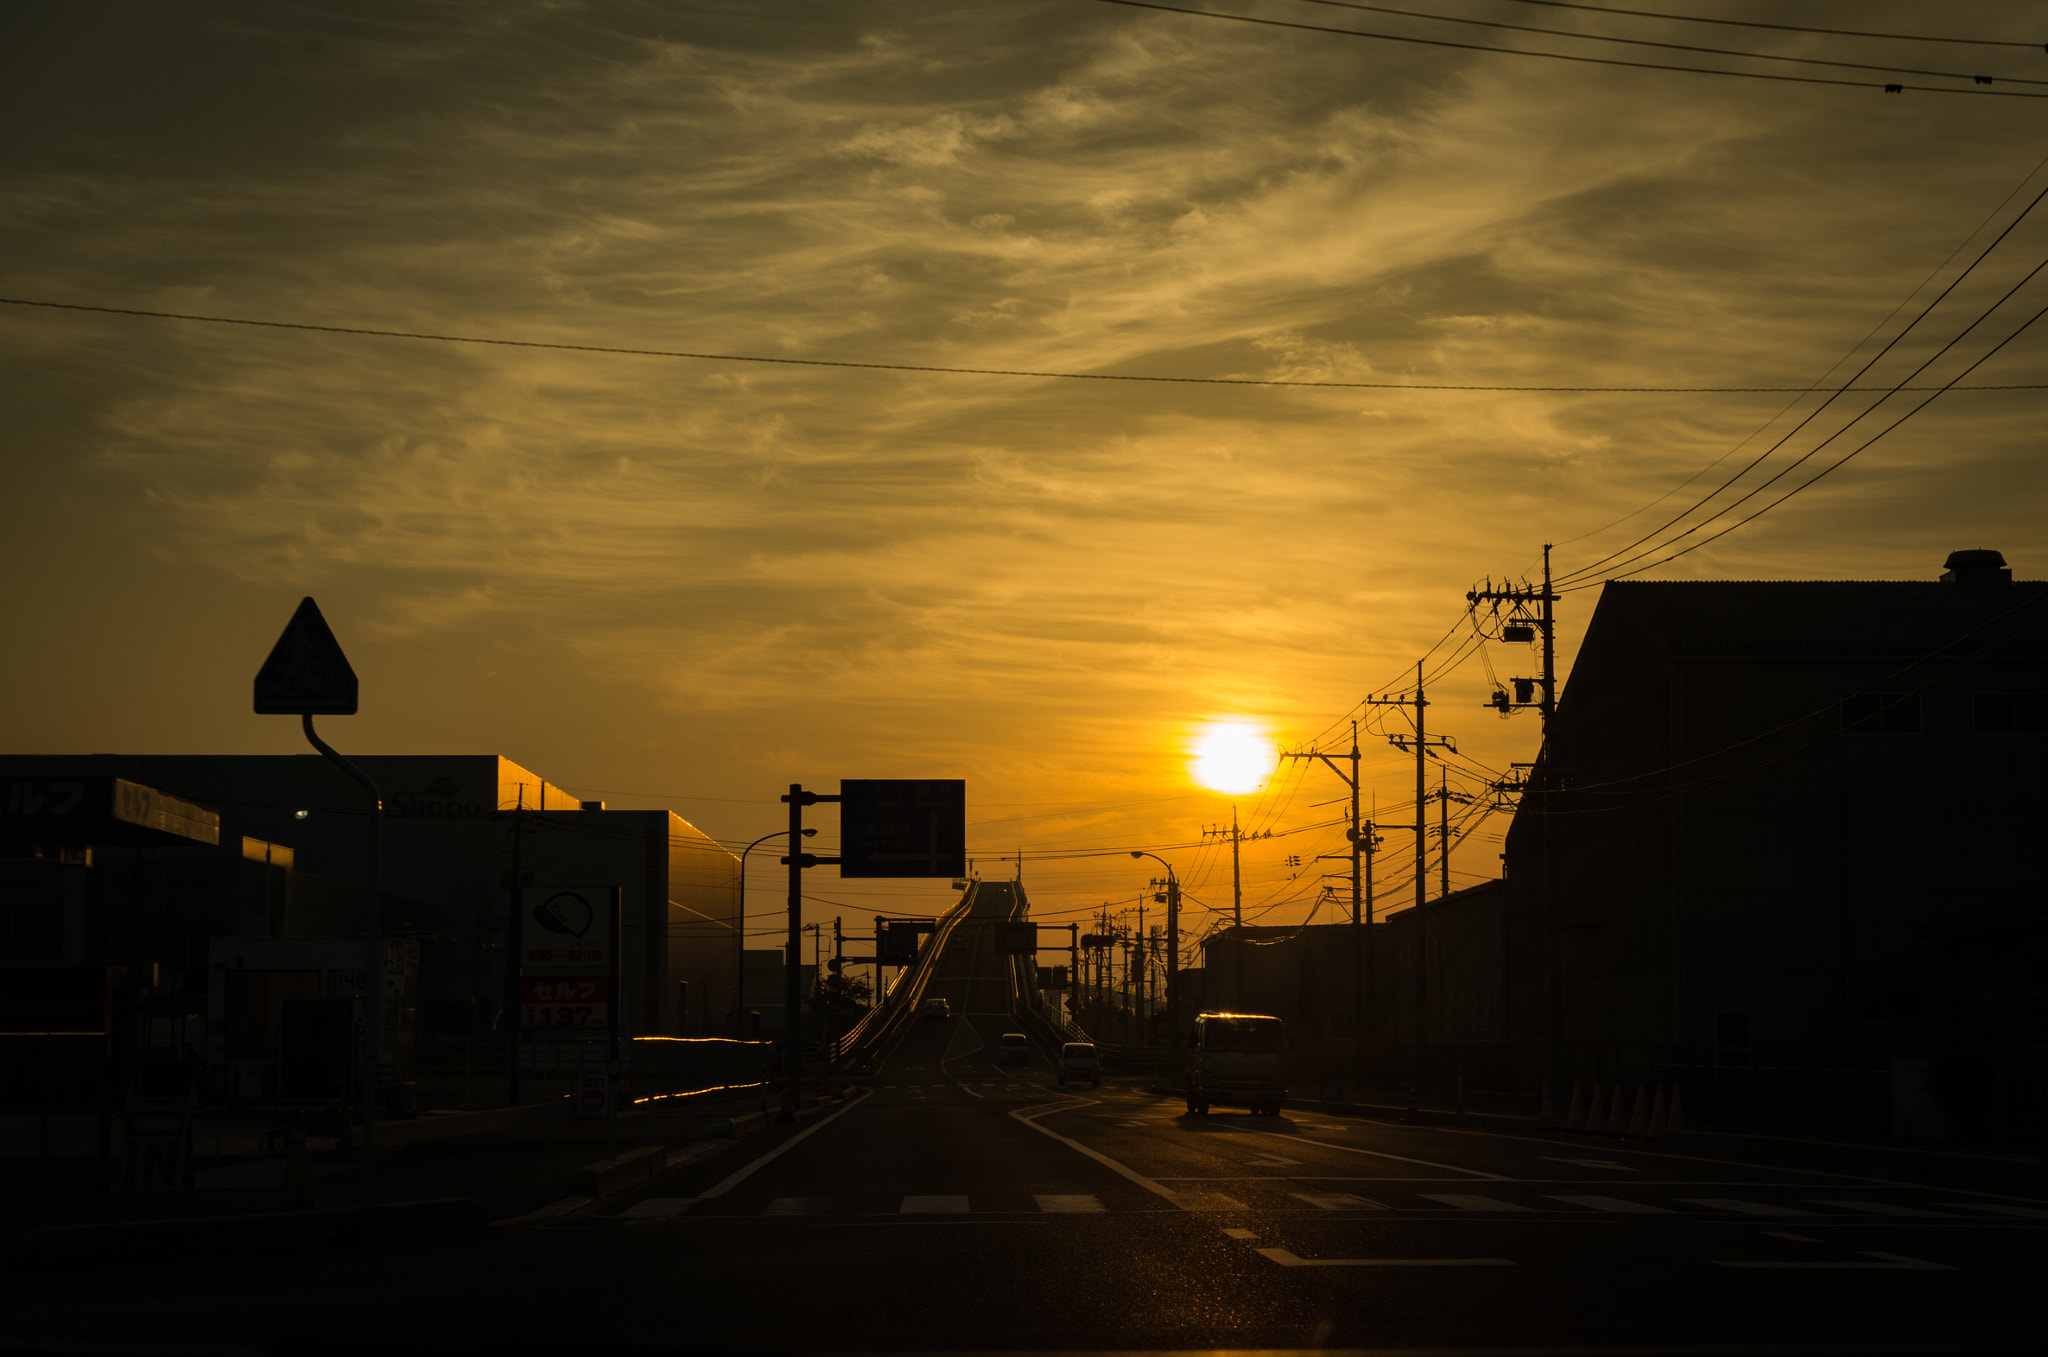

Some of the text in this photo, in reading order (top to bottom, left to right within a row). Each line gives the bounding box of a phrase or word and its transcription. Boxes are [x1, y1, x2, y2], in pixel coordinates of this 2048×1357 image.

[0, 781, 86, 816] ルフ
[386, 791, 481, 821] Sanpo
[533, 980, 597, 1001] セルフ
[540, 1006, 593, 1026] 137
[125, 1140, 180, 1187] IN
